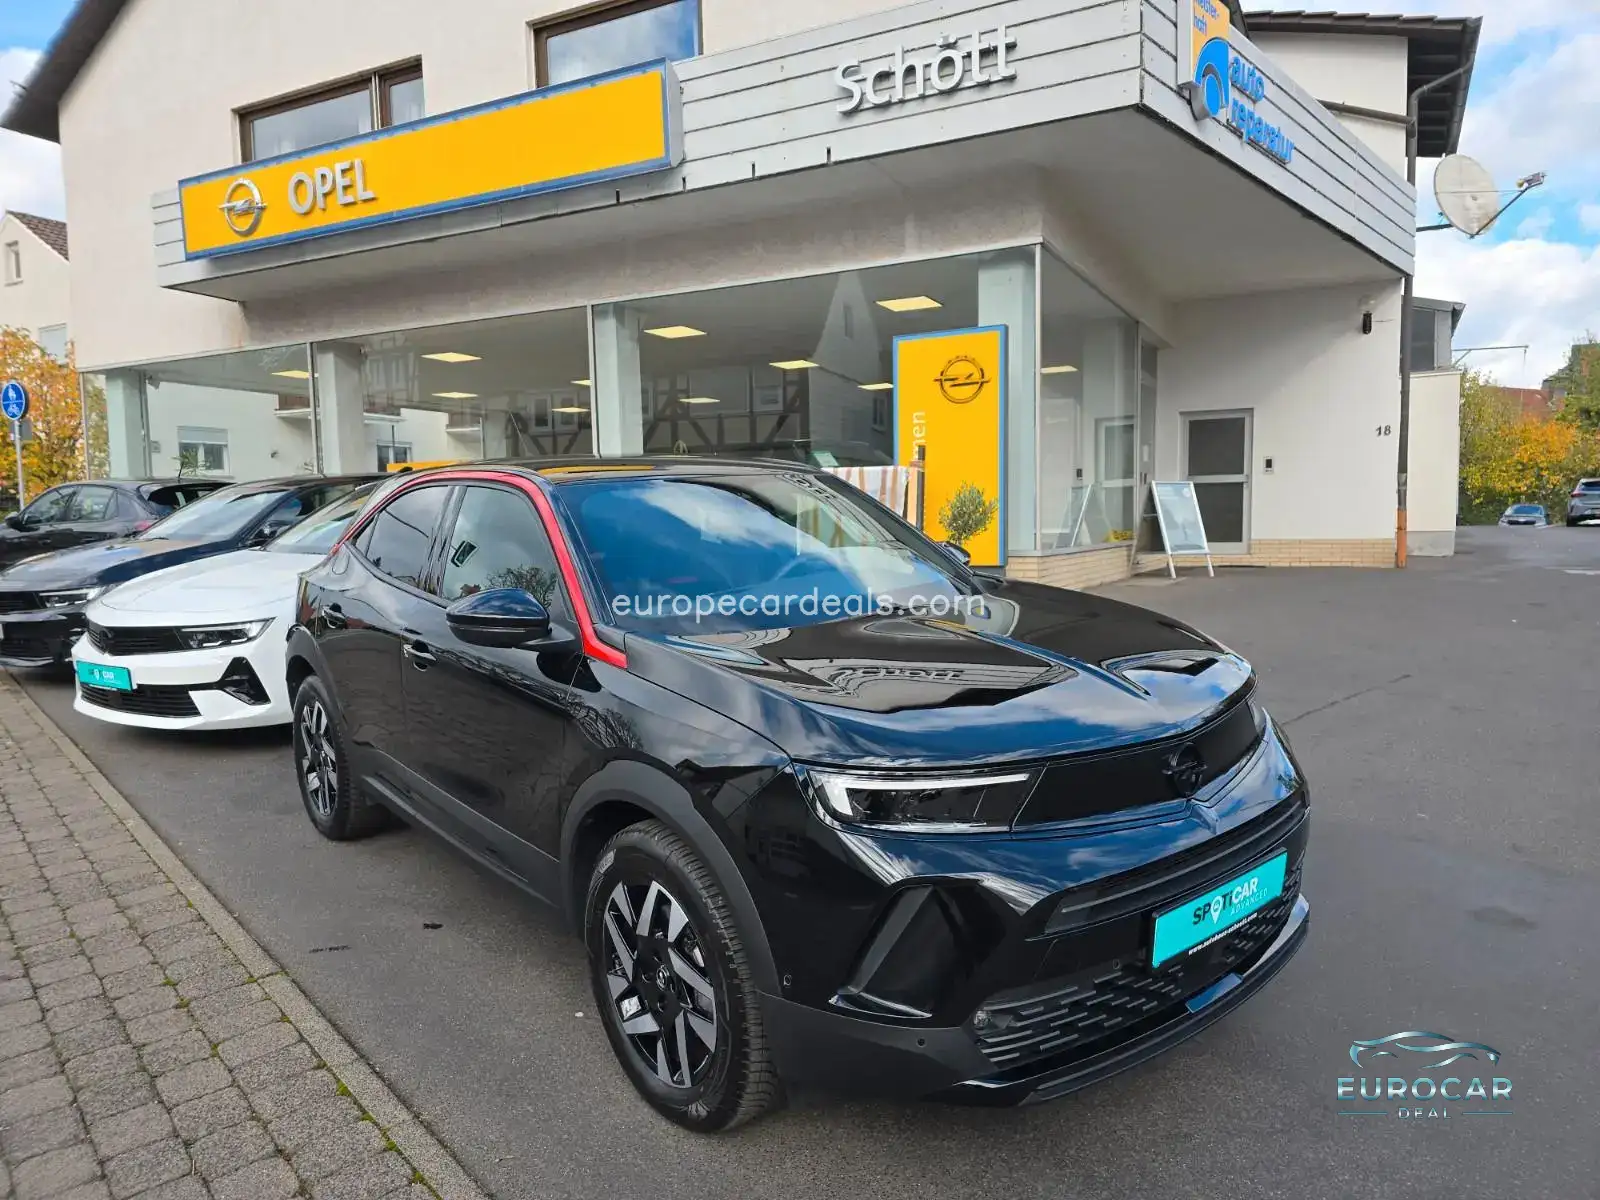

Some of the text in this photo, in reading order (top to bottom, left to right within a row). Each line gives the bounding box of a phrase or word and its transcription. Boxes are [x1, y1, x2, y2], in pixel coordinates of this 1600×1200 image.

[834, 23, 1018, 114] Schött
[1230, 56, 1265, 103] auto
[1231, 97, 1295, 165] reparatur
[288, 158, 376, 215] OPEL
[1375, 424, 1392, 437] 18
